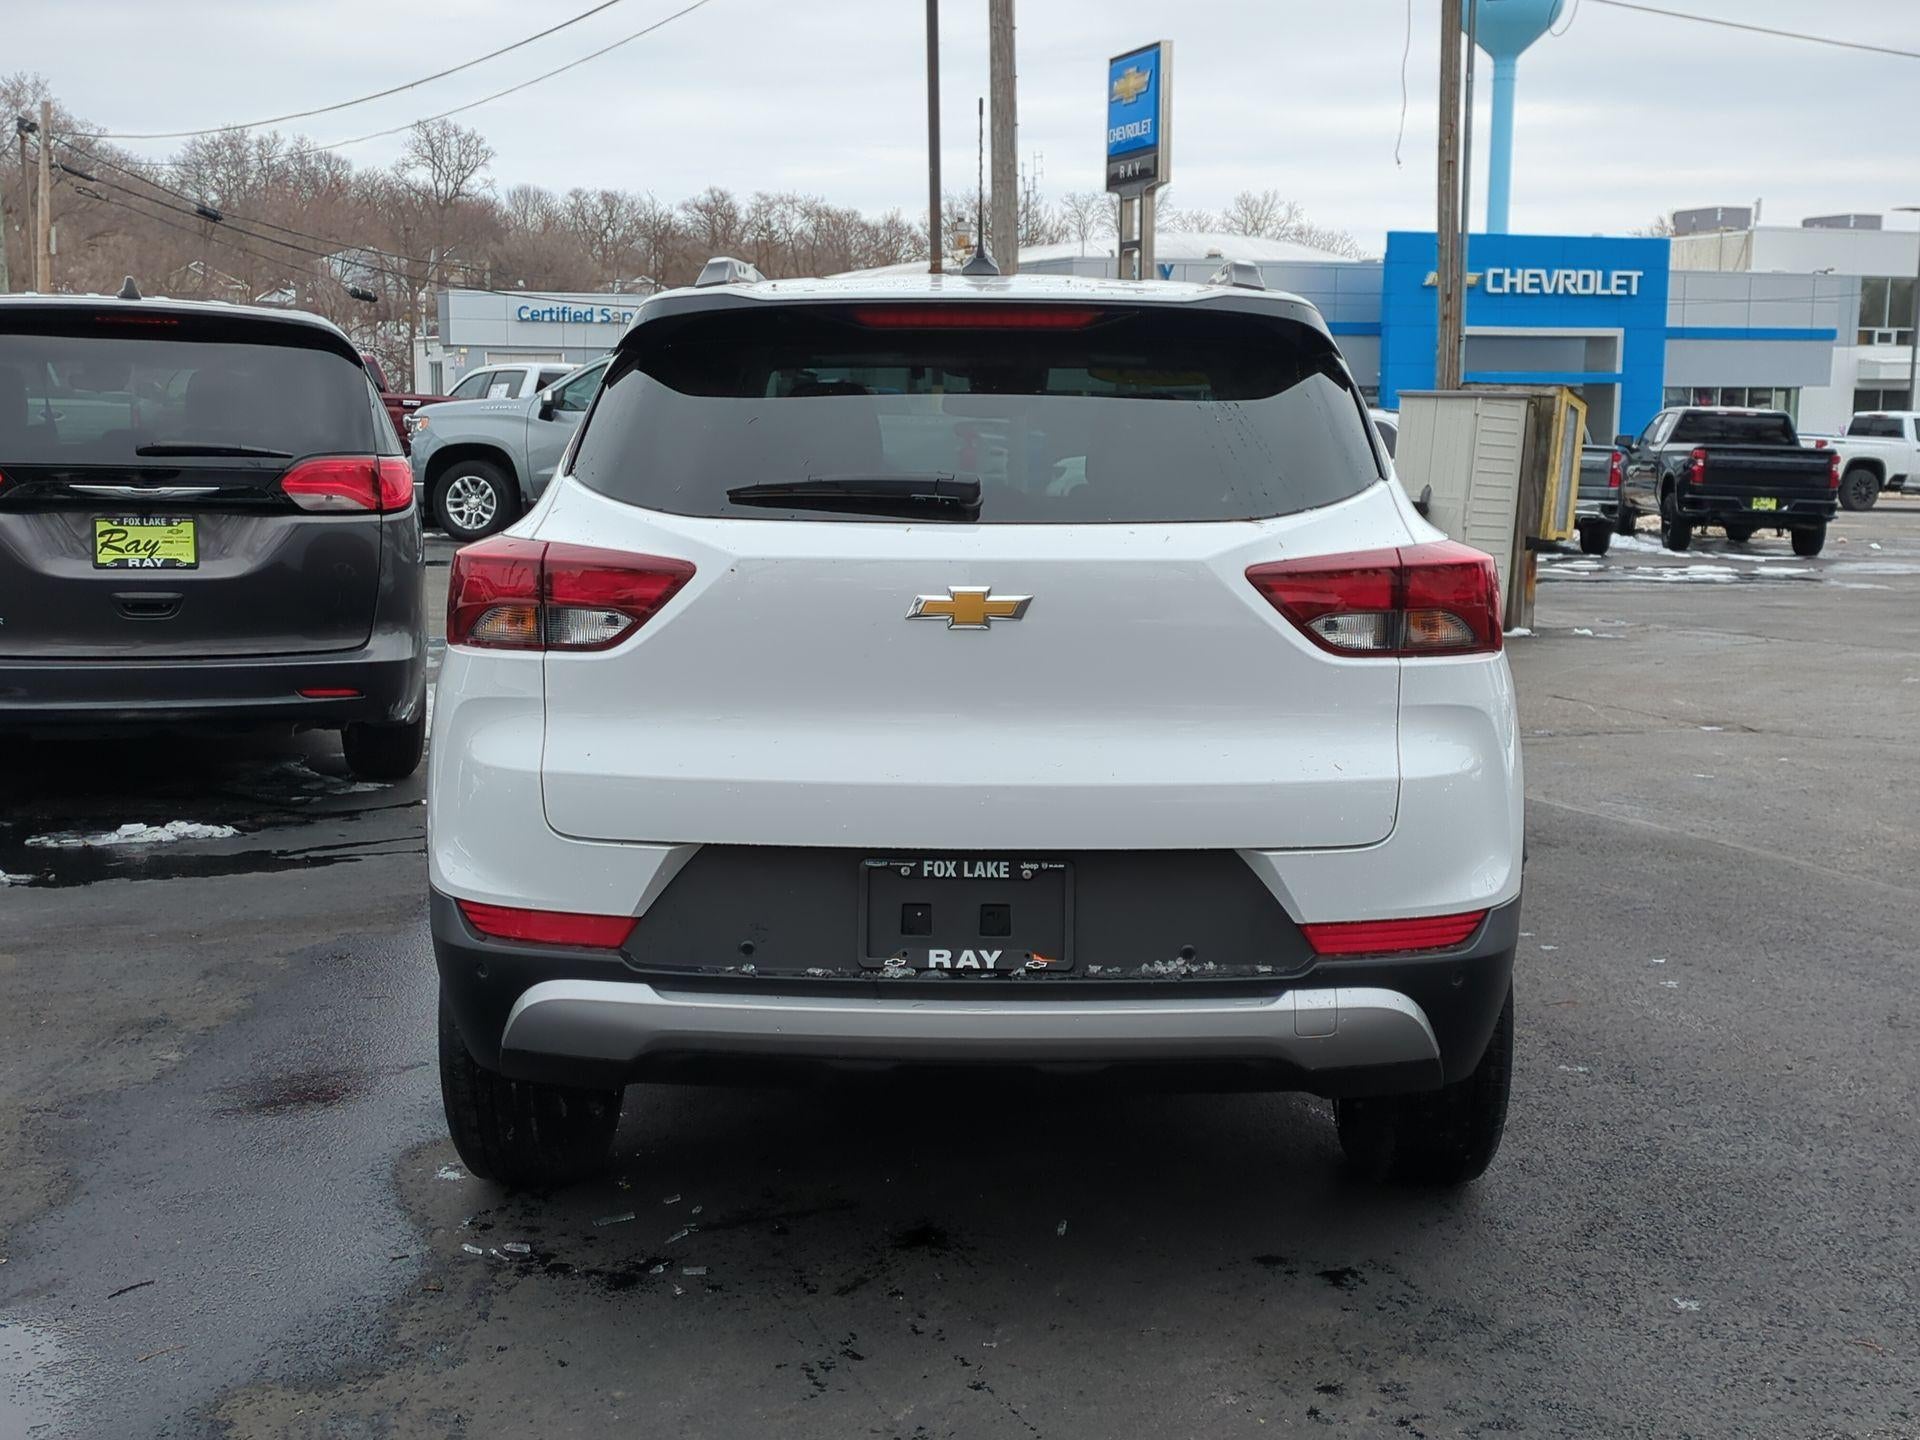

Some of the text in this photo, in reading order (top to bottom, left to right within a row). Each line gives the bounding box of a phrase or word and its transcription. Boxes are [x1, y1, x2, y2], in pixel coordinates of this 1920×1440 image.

[1109, 118, 1152, 144] CHEVROLET
[1119, 161, 1141, 179] RAY
[1486, 268, 1643, 295] CHEVROLET
[517, 305, 594, 323] Certified
[123, 517, 141, 526] FOX
[143, 517, 167, 526] LAKE
[98, 528, 161, 558] Ray
[127, 558, 165, 568] RAY
[923, 860, 1010, 878] FOX LAKE
[1020, 861, 1039, 870] Jeep
[928, 949, 1003, 970] RAY
